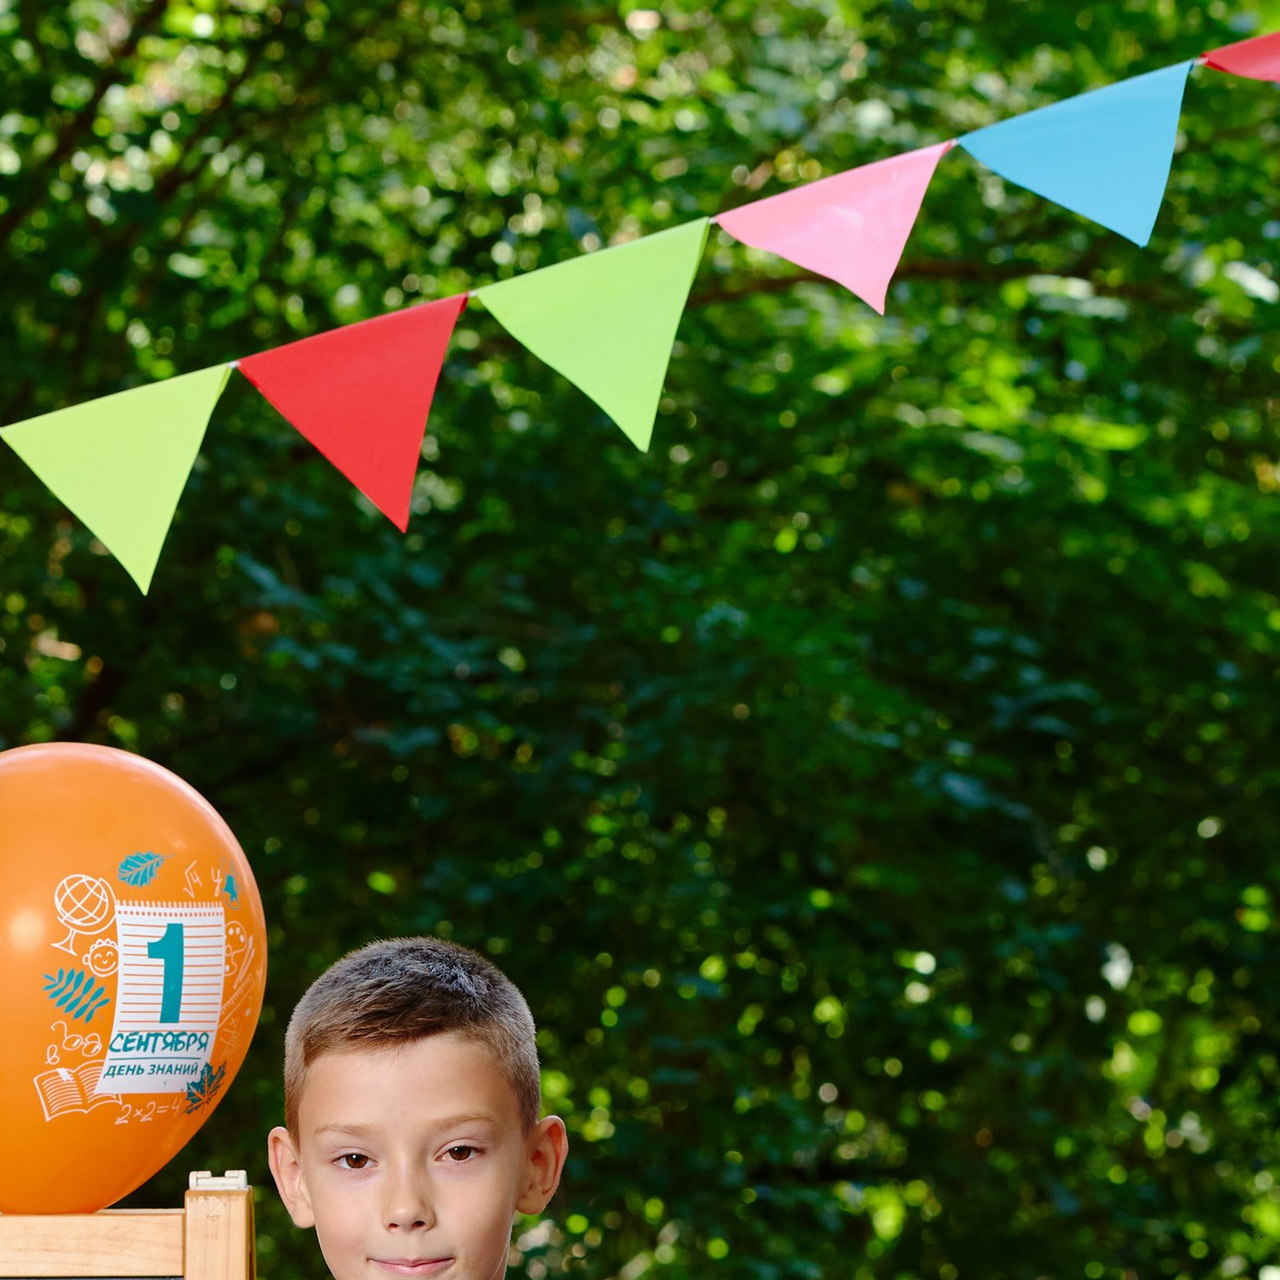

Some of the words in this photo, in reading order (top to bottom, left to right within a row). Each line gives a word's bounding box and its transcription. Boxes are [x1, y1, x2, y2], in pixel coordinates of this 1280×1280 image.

[147, 922, 184, 1024] 1
[108, 1030, 210, 1054] СЕНТЯБРЯ
[102, 1063, 145, 1079] ДЕНЬ
[146, 1061, 200, 1076] ЗНАНИЙ
